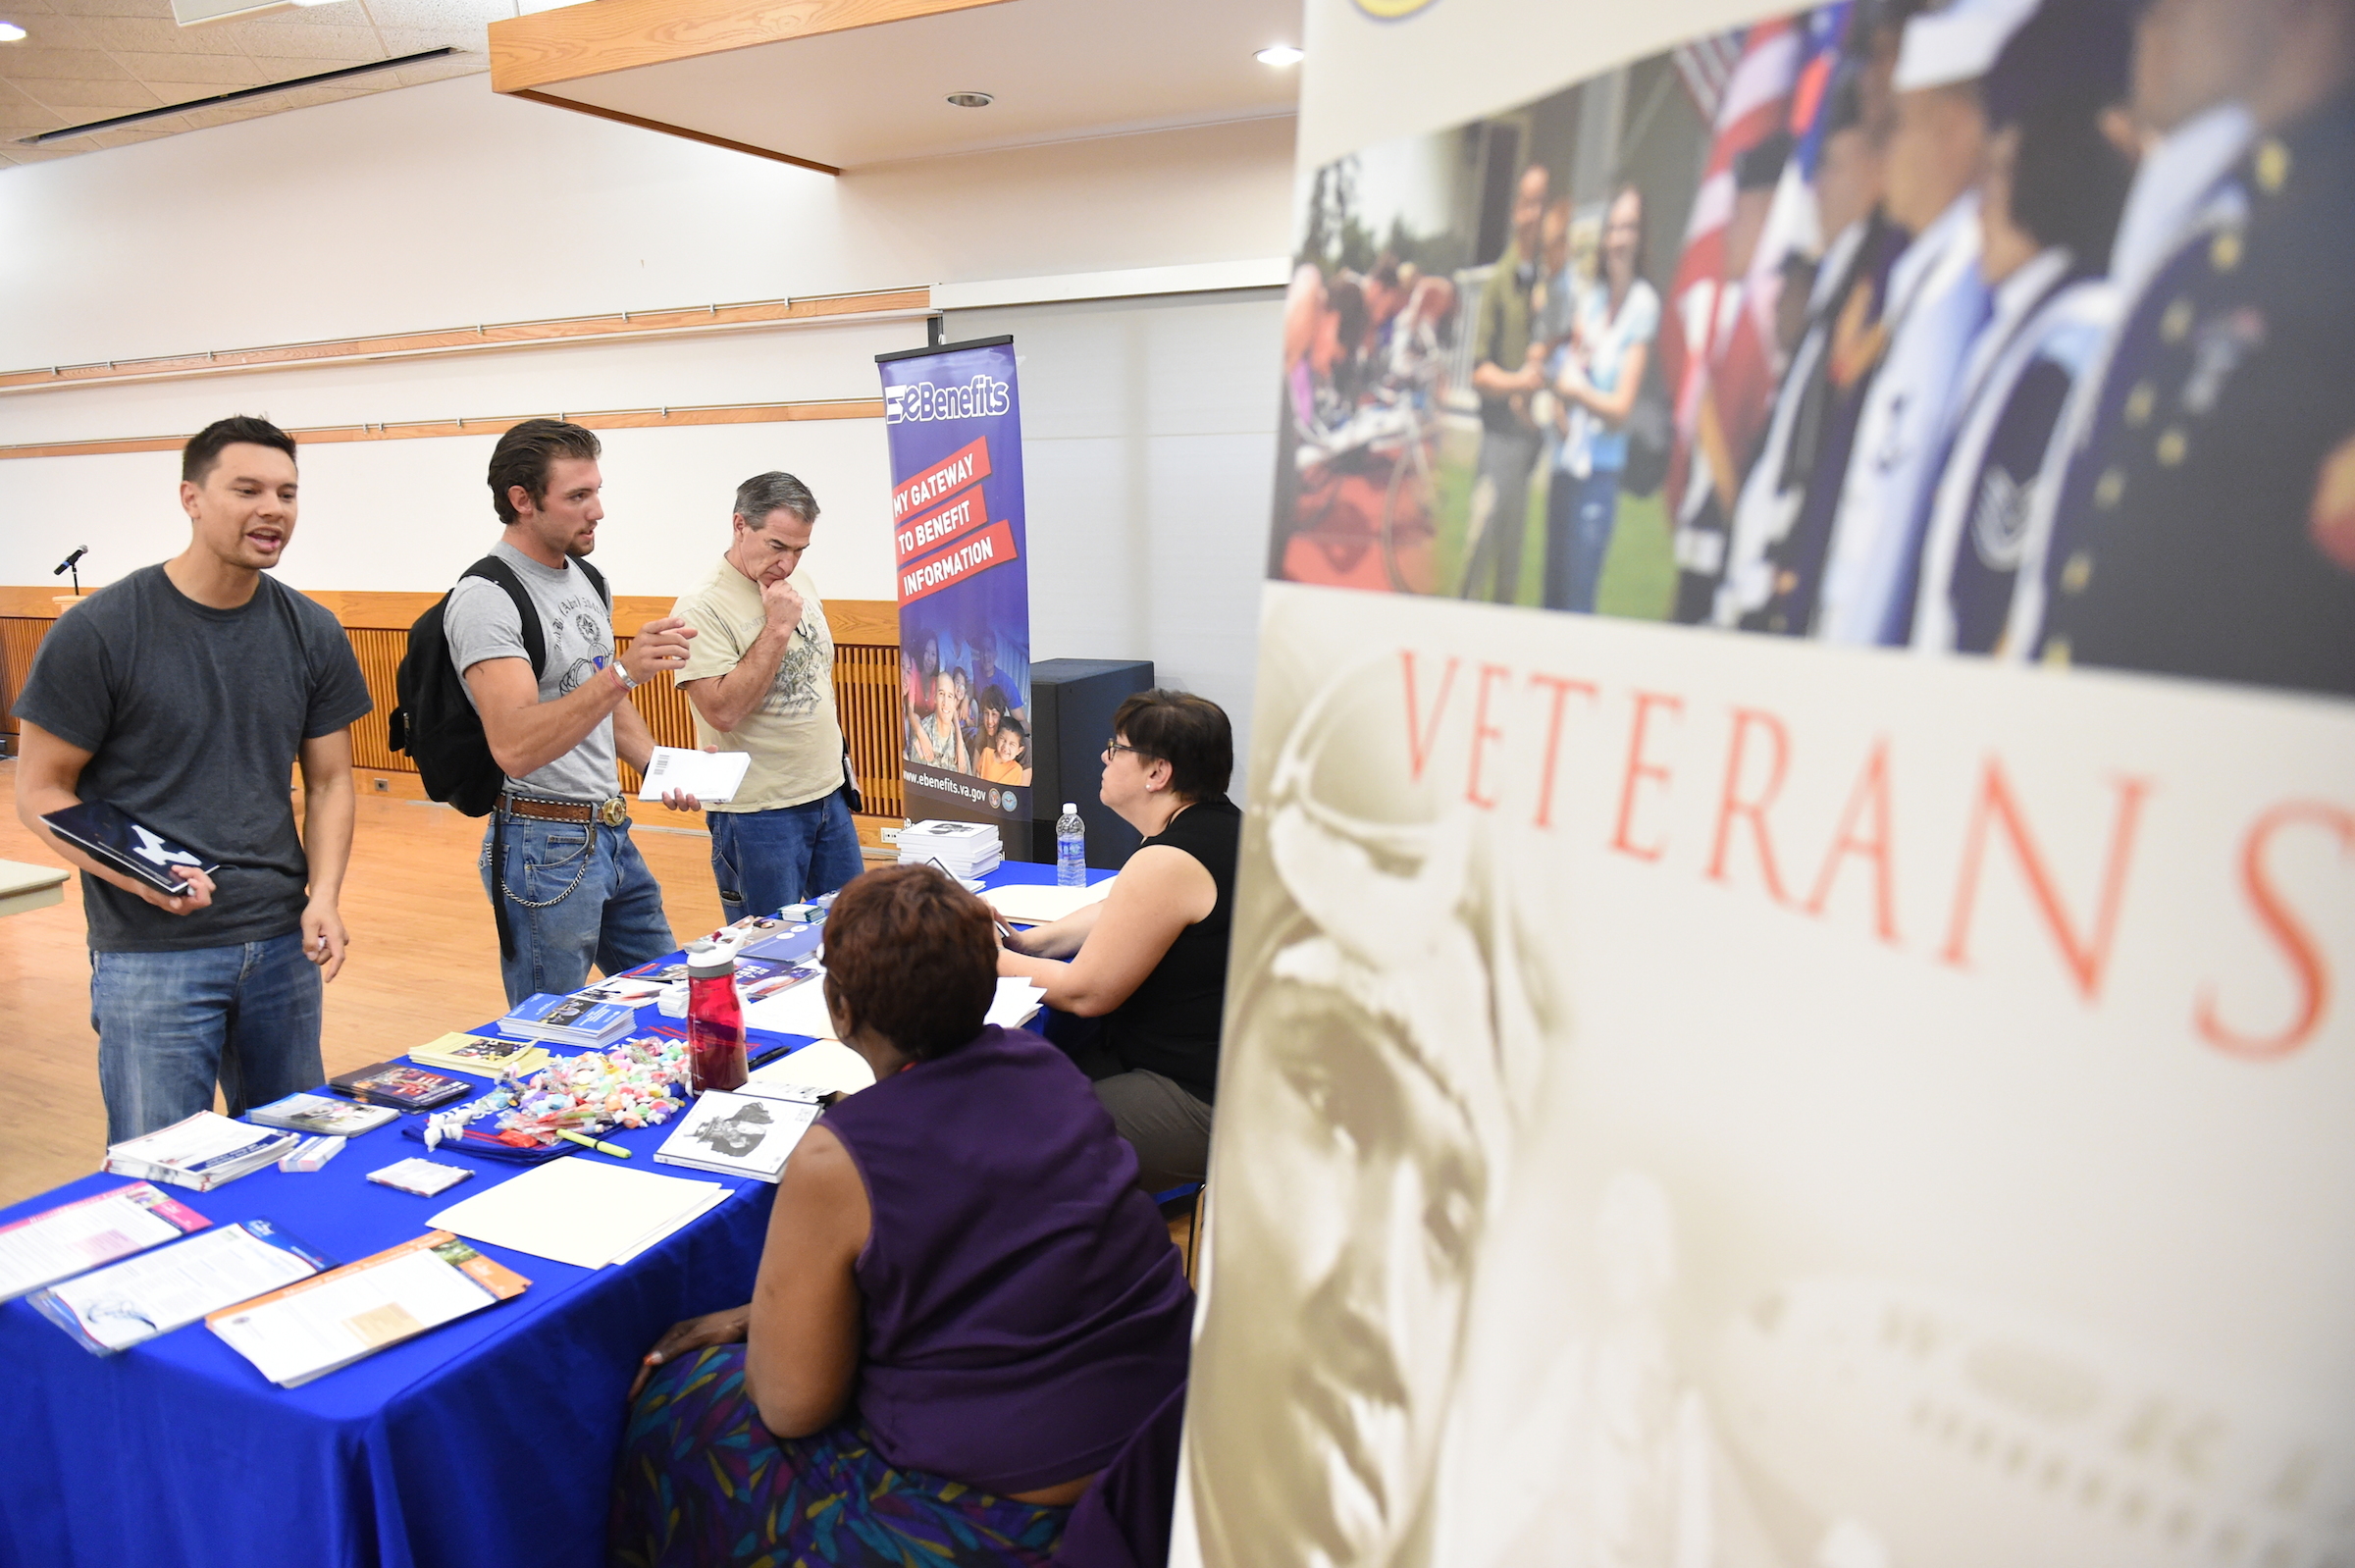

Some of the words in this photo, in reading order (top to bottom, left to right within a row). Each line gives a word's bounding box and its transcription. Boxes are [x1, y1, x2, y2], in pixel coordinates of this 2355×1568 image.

[902, 374, 1010, 422] eBenefits
[893, 490, 909, 517] MY
[911, 452, 974, 506] GATEWAY
[898, 531, 914, 555] TO
[916, 499, 971, 547] BENEFIT
[903, 536, 994, 596] INFORMATION
[903, 769, 986, 803] www.ebenefits.va.gov
[1397, 648, 2355, 1064] VETERANS
